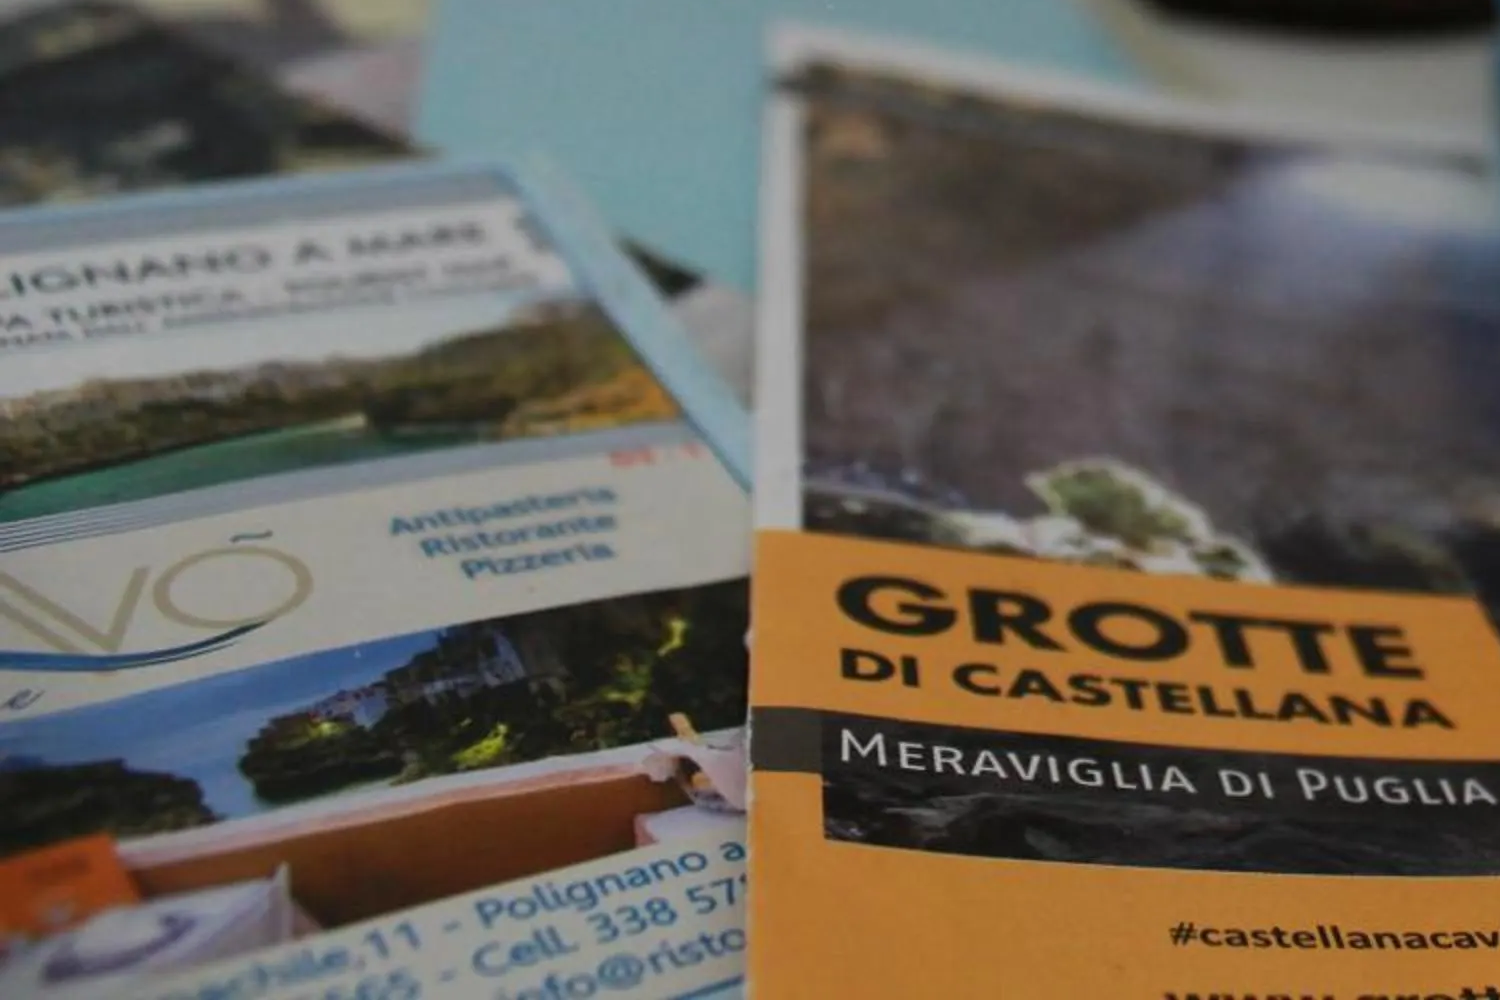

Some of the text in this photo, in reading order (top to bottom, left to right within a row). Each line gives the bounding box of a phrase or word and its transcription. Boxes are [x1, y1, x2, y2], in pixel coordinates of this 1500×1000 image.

[389, 485, 619, 537] Antipasteria
[419, 513, 618, 560] Ristorante
[460, 541, 616, 580] Pizzeria
[835, 574, 1427, 681] GROTTE
[839, 647, 1457, 730] DI CASTELLANA
[839, 727, 1499, 807] MERAVIGLIA DI PUGLIA
[474, 850, 709, 931] Polignano
[718, 840, 746, 863] a
[586, 896, 679, 945] 338
[496, 928, 747, 1000] fo@risto
